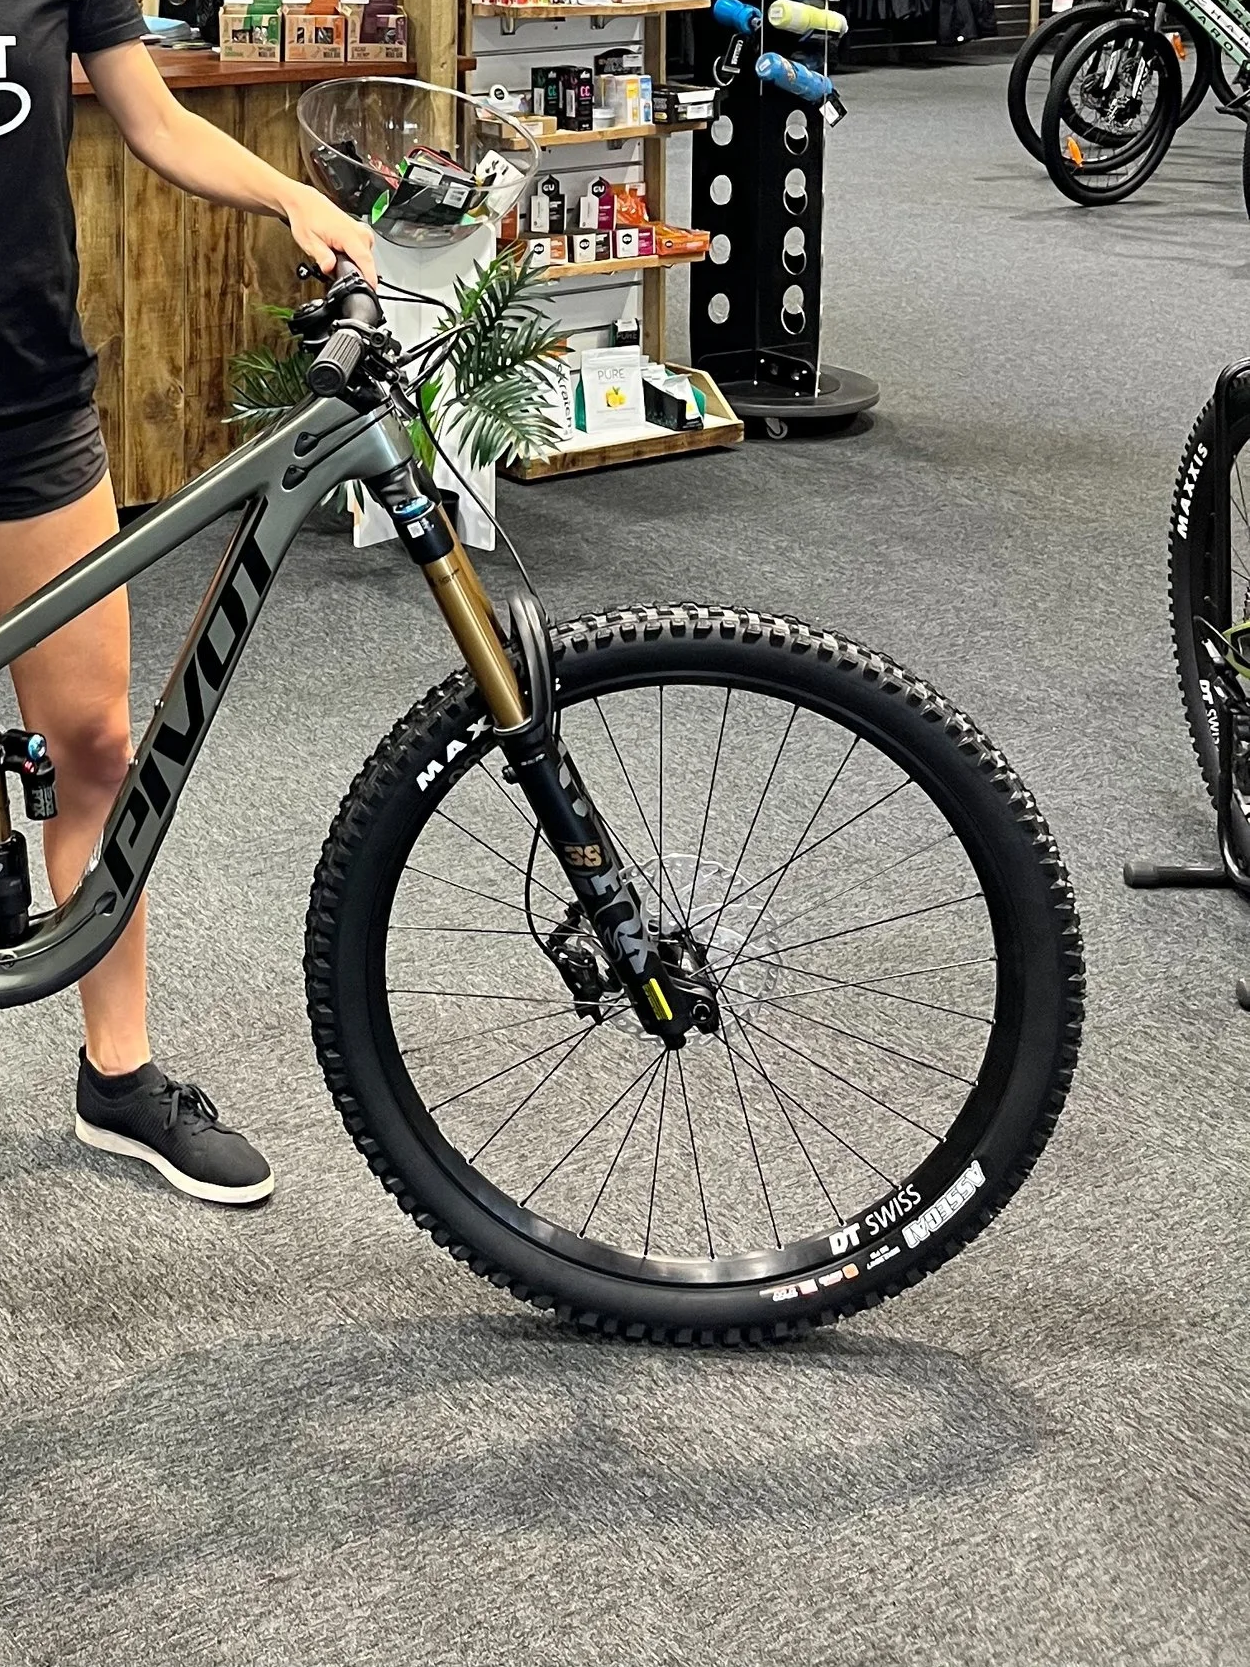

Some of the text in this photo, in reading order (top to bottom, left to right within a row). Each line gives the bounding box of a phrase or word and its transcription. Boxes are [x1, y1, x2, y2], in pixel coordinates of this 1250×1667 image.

[542, 183, 555, 192] GU
[592, 185, 605, 193] GU
[597, 368, 625, 381] PURE
[1177, 442, 1209, 540] MAXXIS
[104, 495, 273, 899] PIVOT
[1200, 679, 1214, 706] DT
[590, 866, 659, 975] FOX
[828, 1183, 922, 1256] DT SWISS
[901, 1159, 987, 1250] ASSEGAI
